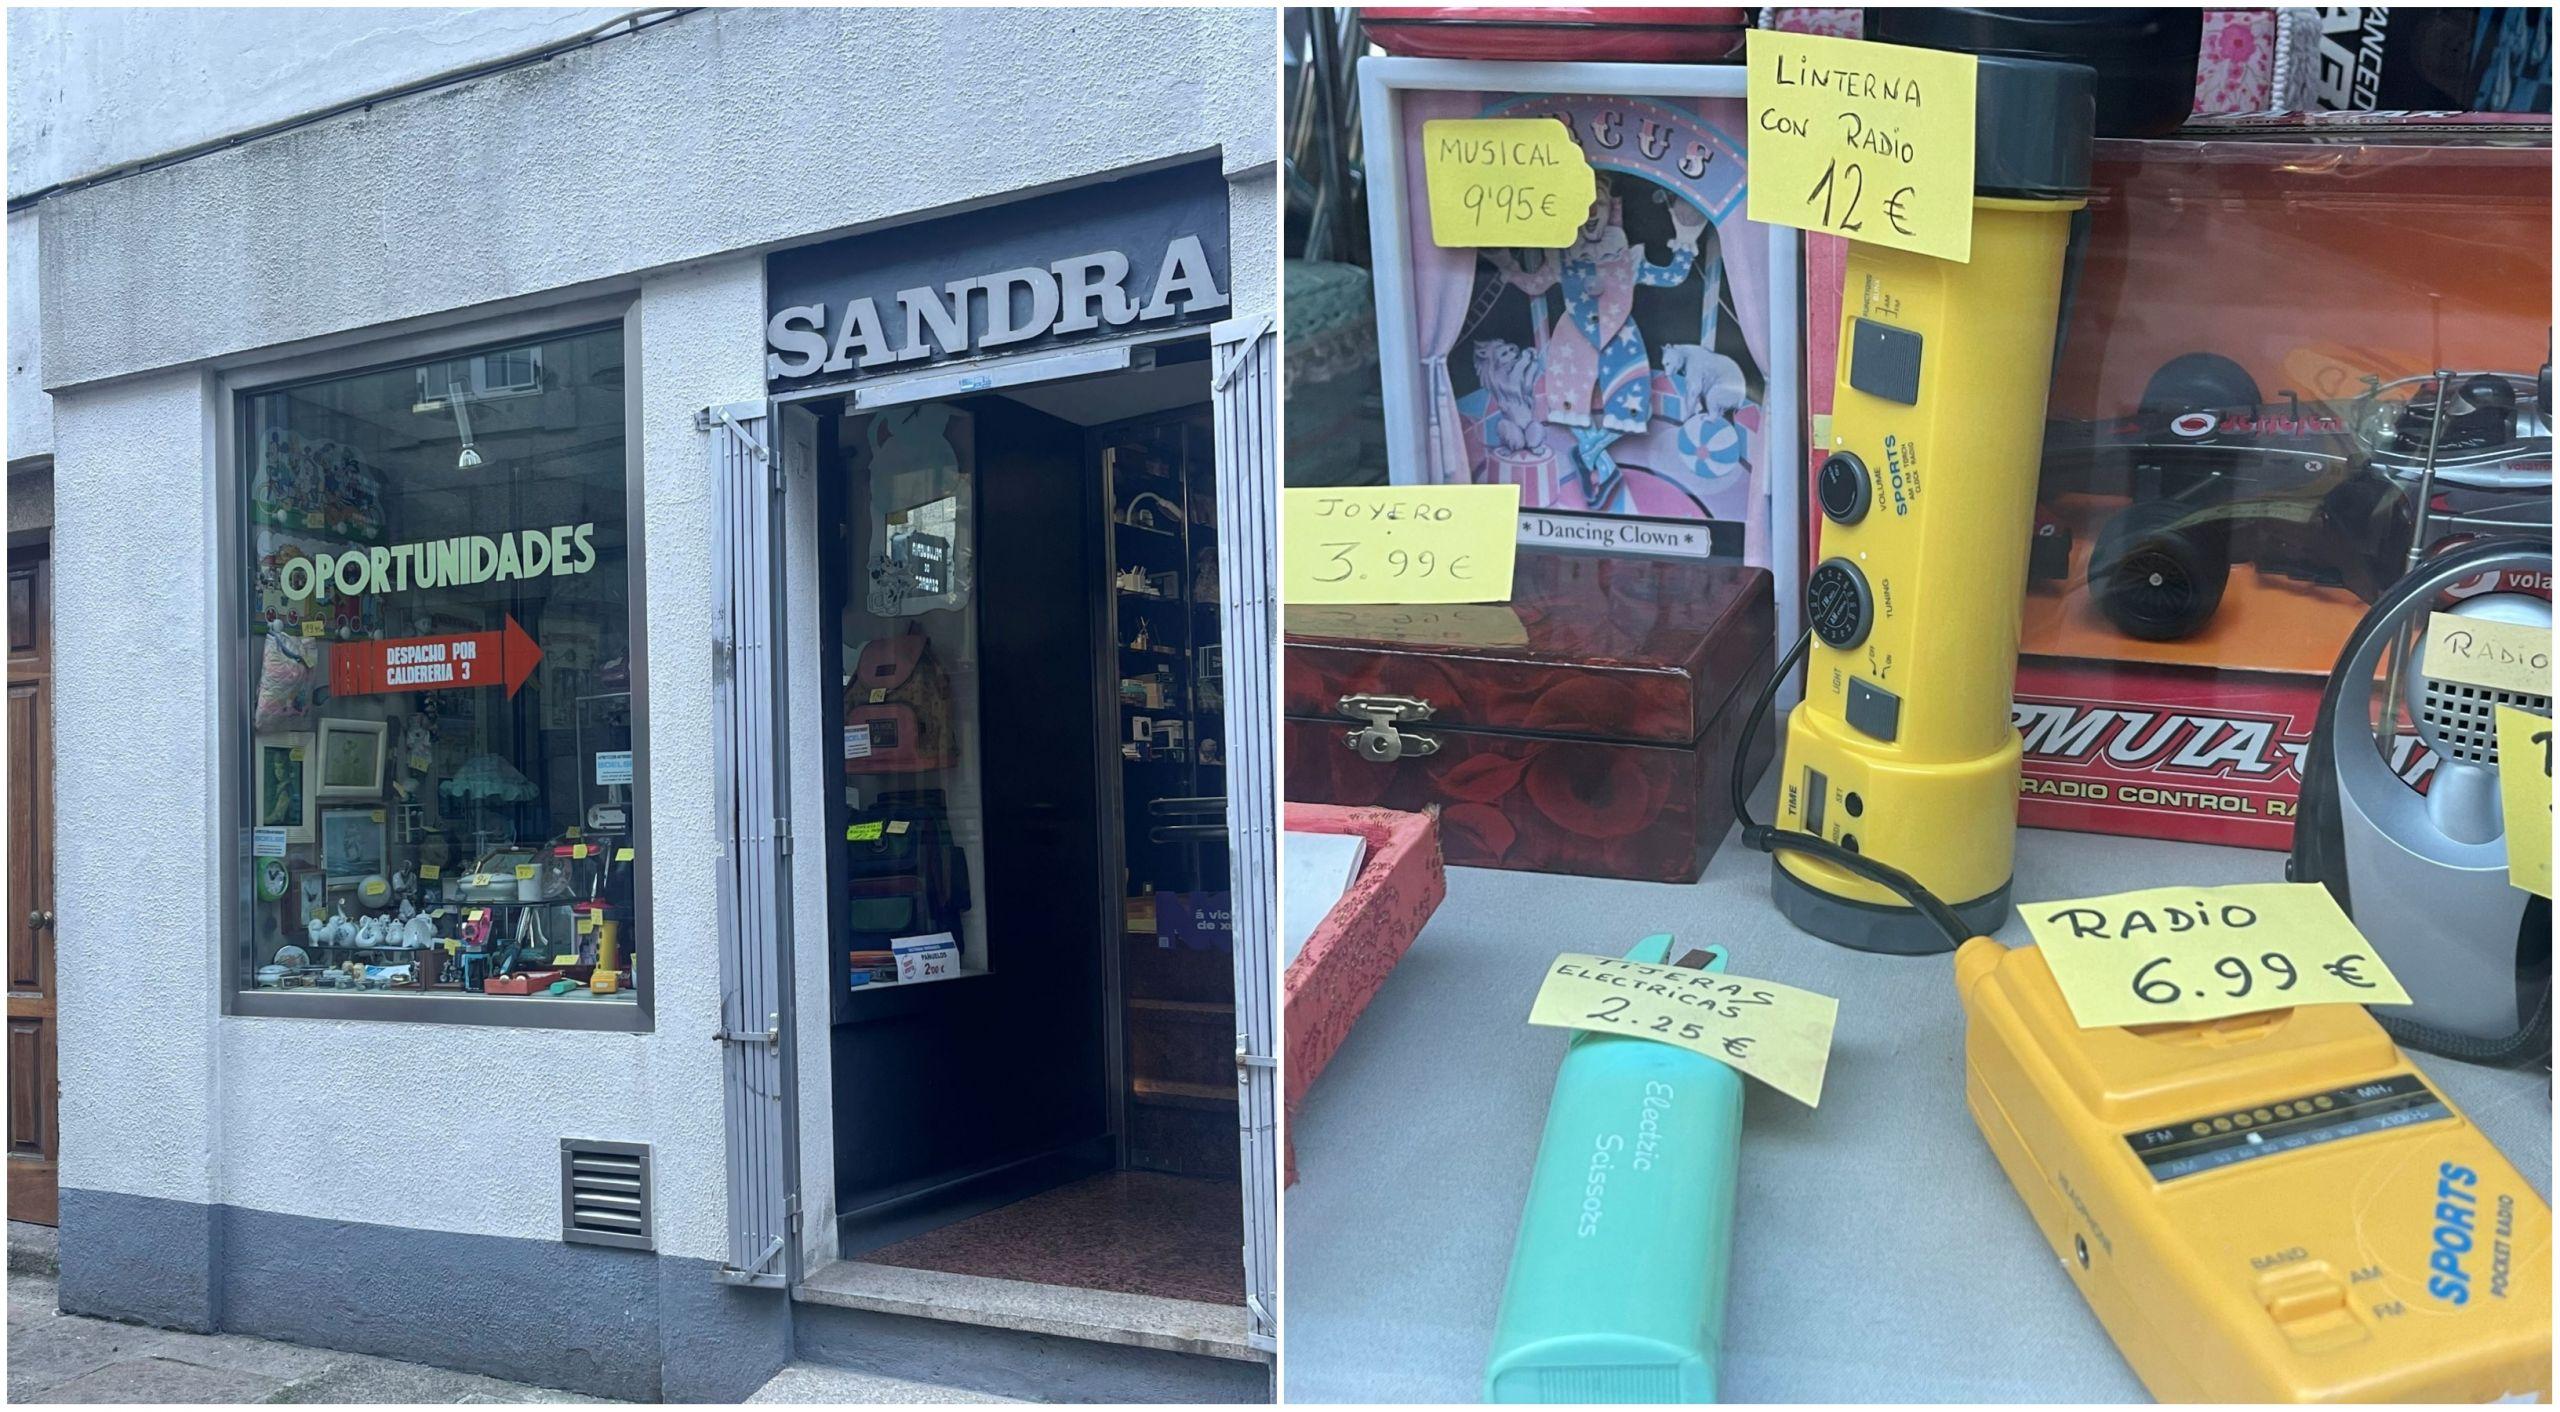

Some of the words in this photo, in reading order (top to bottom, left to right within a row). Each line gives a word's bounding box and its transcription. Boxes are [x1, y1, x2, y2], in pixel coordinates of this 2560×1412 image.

[2353, 7, 2390, 111] ANCED
[1760, 108, 1811, 138] CON
[1439, 137, 1560, 167] MUSICAL
[1555, 111, 1714, 180] CUS
[1806, 157, 1863, 233] 12
[1883, 185, 1917, 236] €
[767, 234, 1230, 382] SANDRA
[1873, 467, 1887, 511] VOLUME
[1884, 434, 1908, 516] SPORTS
[1913, 470, 1921, 493] CLOCK
[1316, 498, 1453, 521] JOYERO
[1537, 519, 1615, 546] Dancing
[1619, 525, 1679, 546] Clown
[280, 523, 596, 600] OPORTUNIDADES
[1882, 579, 1893, 619] TUNING
[387, 643, 446, 666] DESPACHO
[452, 641, 477, 660] POR
[386, 663, 454, 685] CALDERERIA
[461, 662, 471, 680] 3
[1832, 668, 1843, 694] LIGHT
[1788, 784, 1797, 815] TIME
[2020, 778, 2109, 799] RADIO
[2117, 786, 2258, 813] CONTROL
[1595, 957, 1775, 1006] TIJERAS
[2131, 951, 2299, 1005] 6.99
[2322, 954, 2377, 989] €
[1721, 1036, 1756, 1059] €
[2145, 1129, 2174, 1144] FM
[2495, 1194, 2514, 1237] RADIO
[2428, 1161, 2478, 1306] SPORTS
[2251, 1246, 2309, 1271] BAND
[2351, 1264, 2384, 1284] AM
[2490, 1239, 2510, 1299] POCKET
[2372, 1300, 2407, 1321] FM
